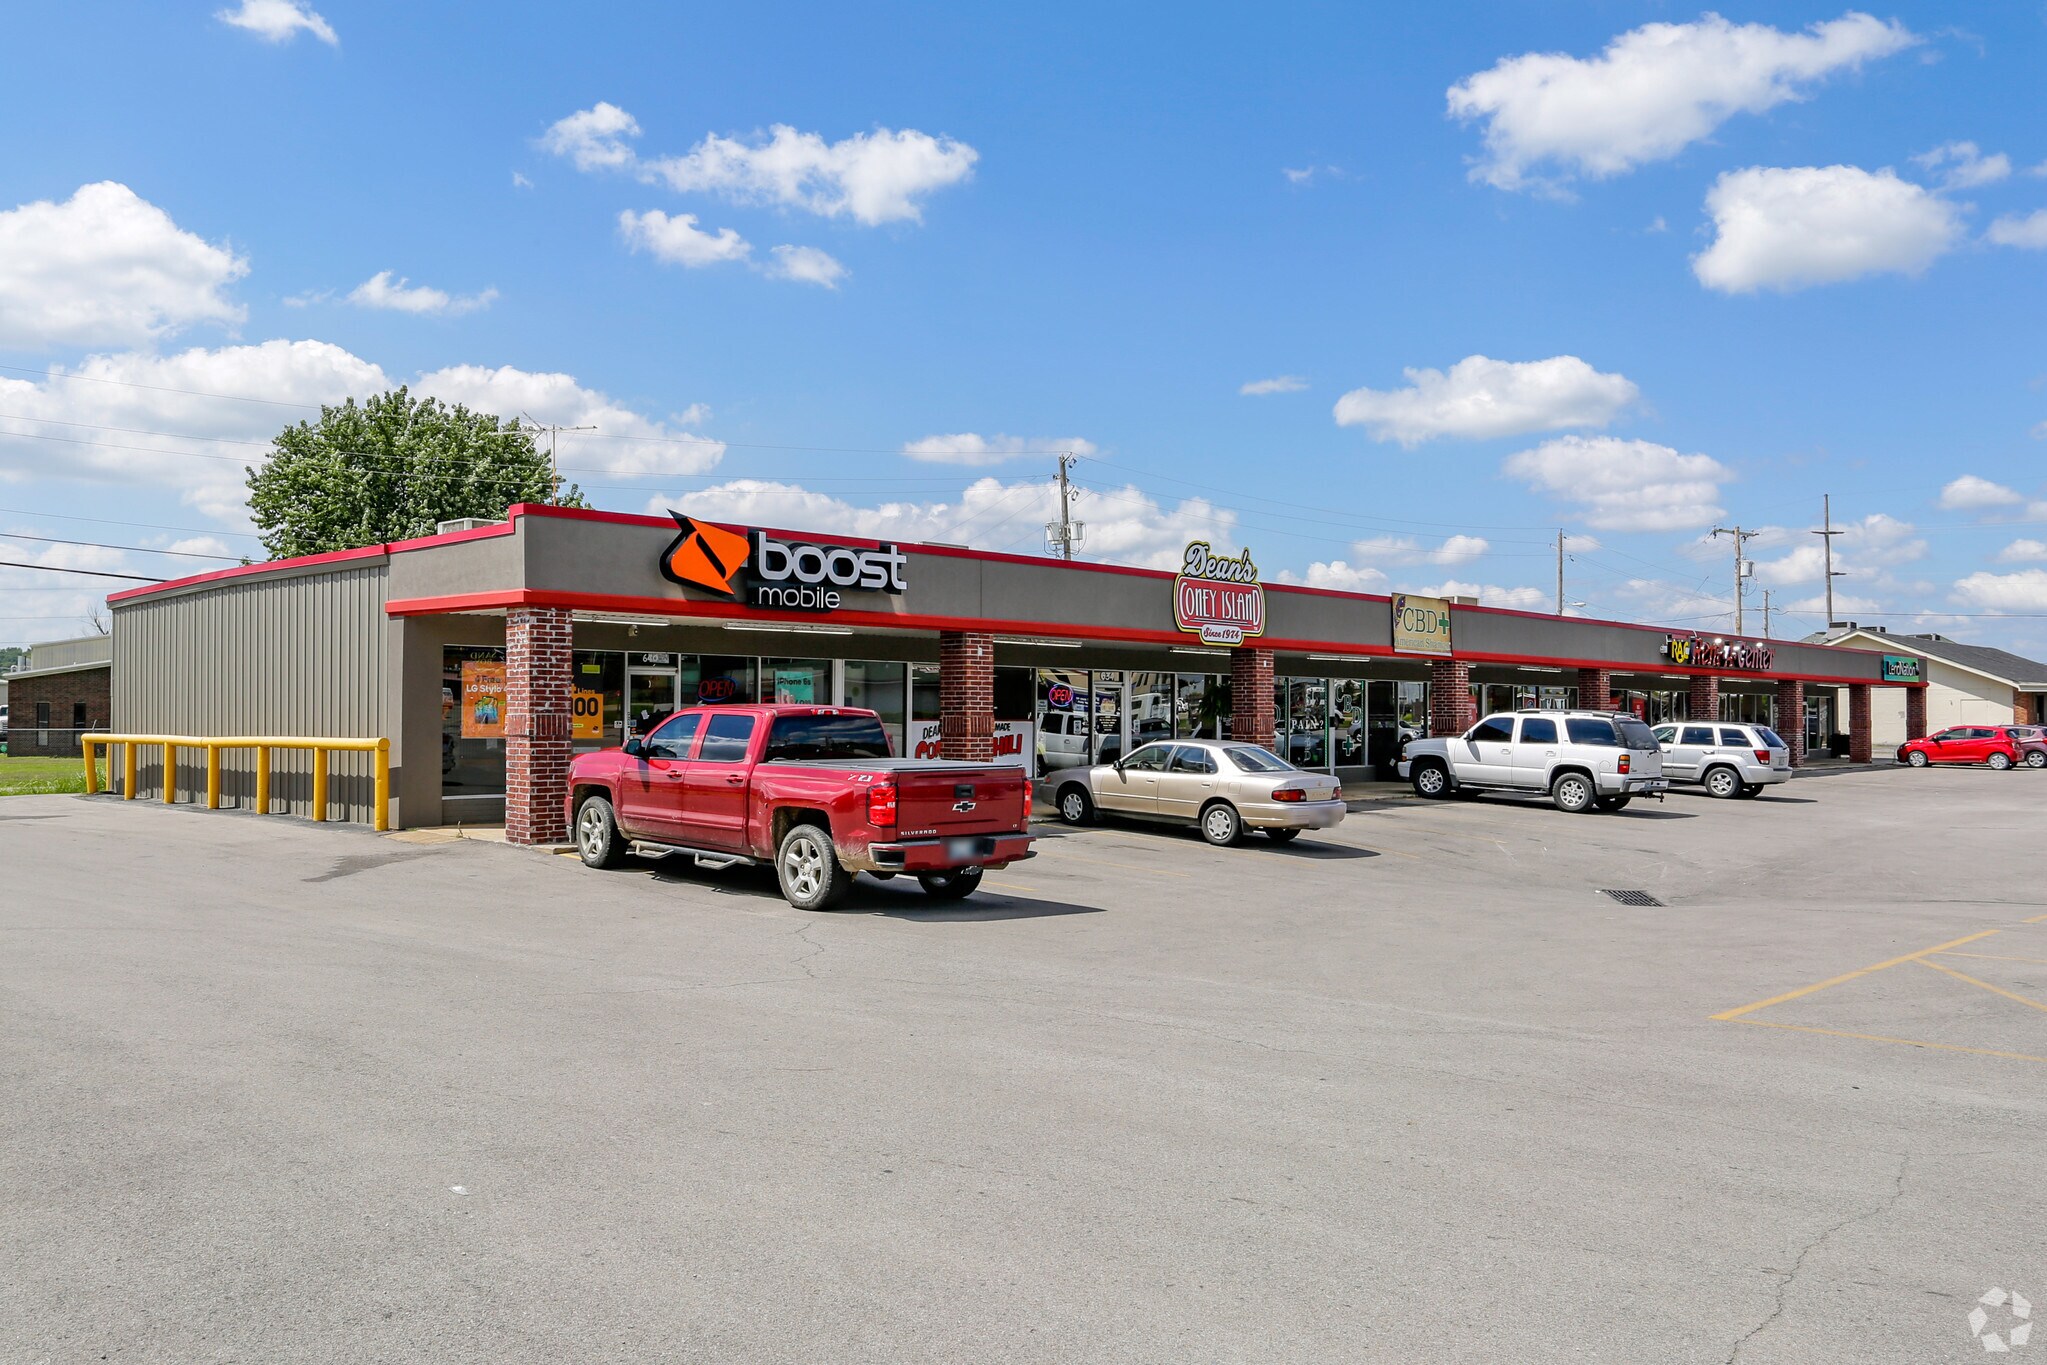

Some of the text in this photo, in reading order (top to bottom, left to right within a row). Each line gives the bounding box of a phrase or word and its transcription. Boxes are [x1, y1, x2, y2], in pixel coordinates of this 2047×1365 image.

[758, 531, 908, 590] boost
[1183, 543, 1257, 583] Dean's
[758, 585, 841, 609] mobile
[1179, 581, 1260, 626] CONEY ISLAND
[1203, 627, 1240, 639] Since 1974
[1672, 640, 1690, 664] RAC
[777, 678, 812, 686] iPhone 6s
[1100, 672, 1115, 681] 634
[466, 684, 478, 693] LG
[479, 684, 502, 694] Stylo
[700, 680, 734, 698] OPEN
[1052, 689, 1072, 701] OPEN
